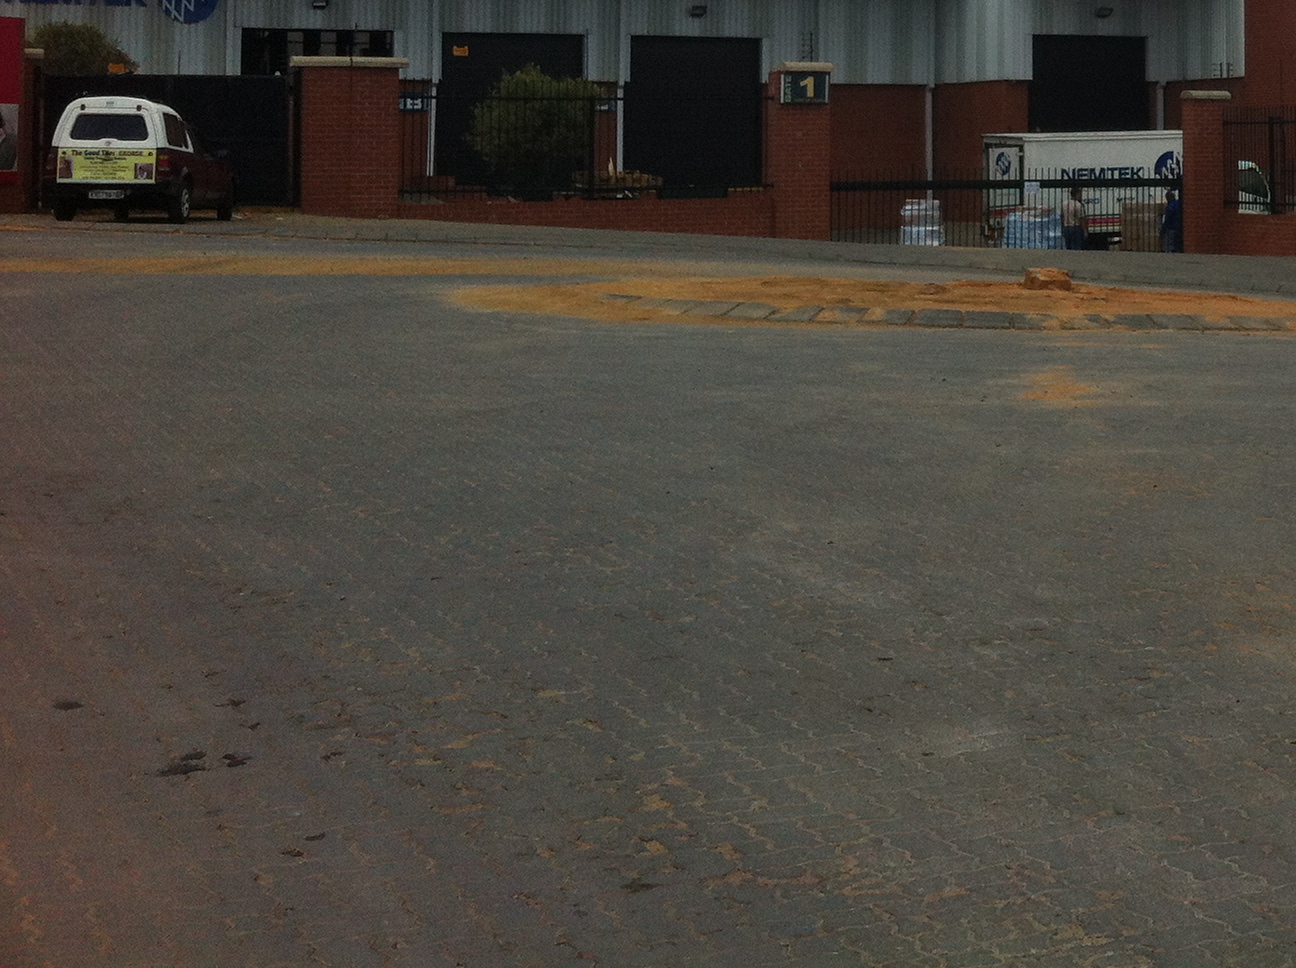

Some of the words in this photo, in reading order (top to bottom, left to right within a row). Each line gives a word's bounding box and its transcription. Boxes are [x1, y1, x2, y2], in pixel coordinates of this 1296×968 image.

[784, 75, 792, 103] GATE
[800, 75, 815, 98] 1
[1061, 167, 1144, 180] NEMTEK
